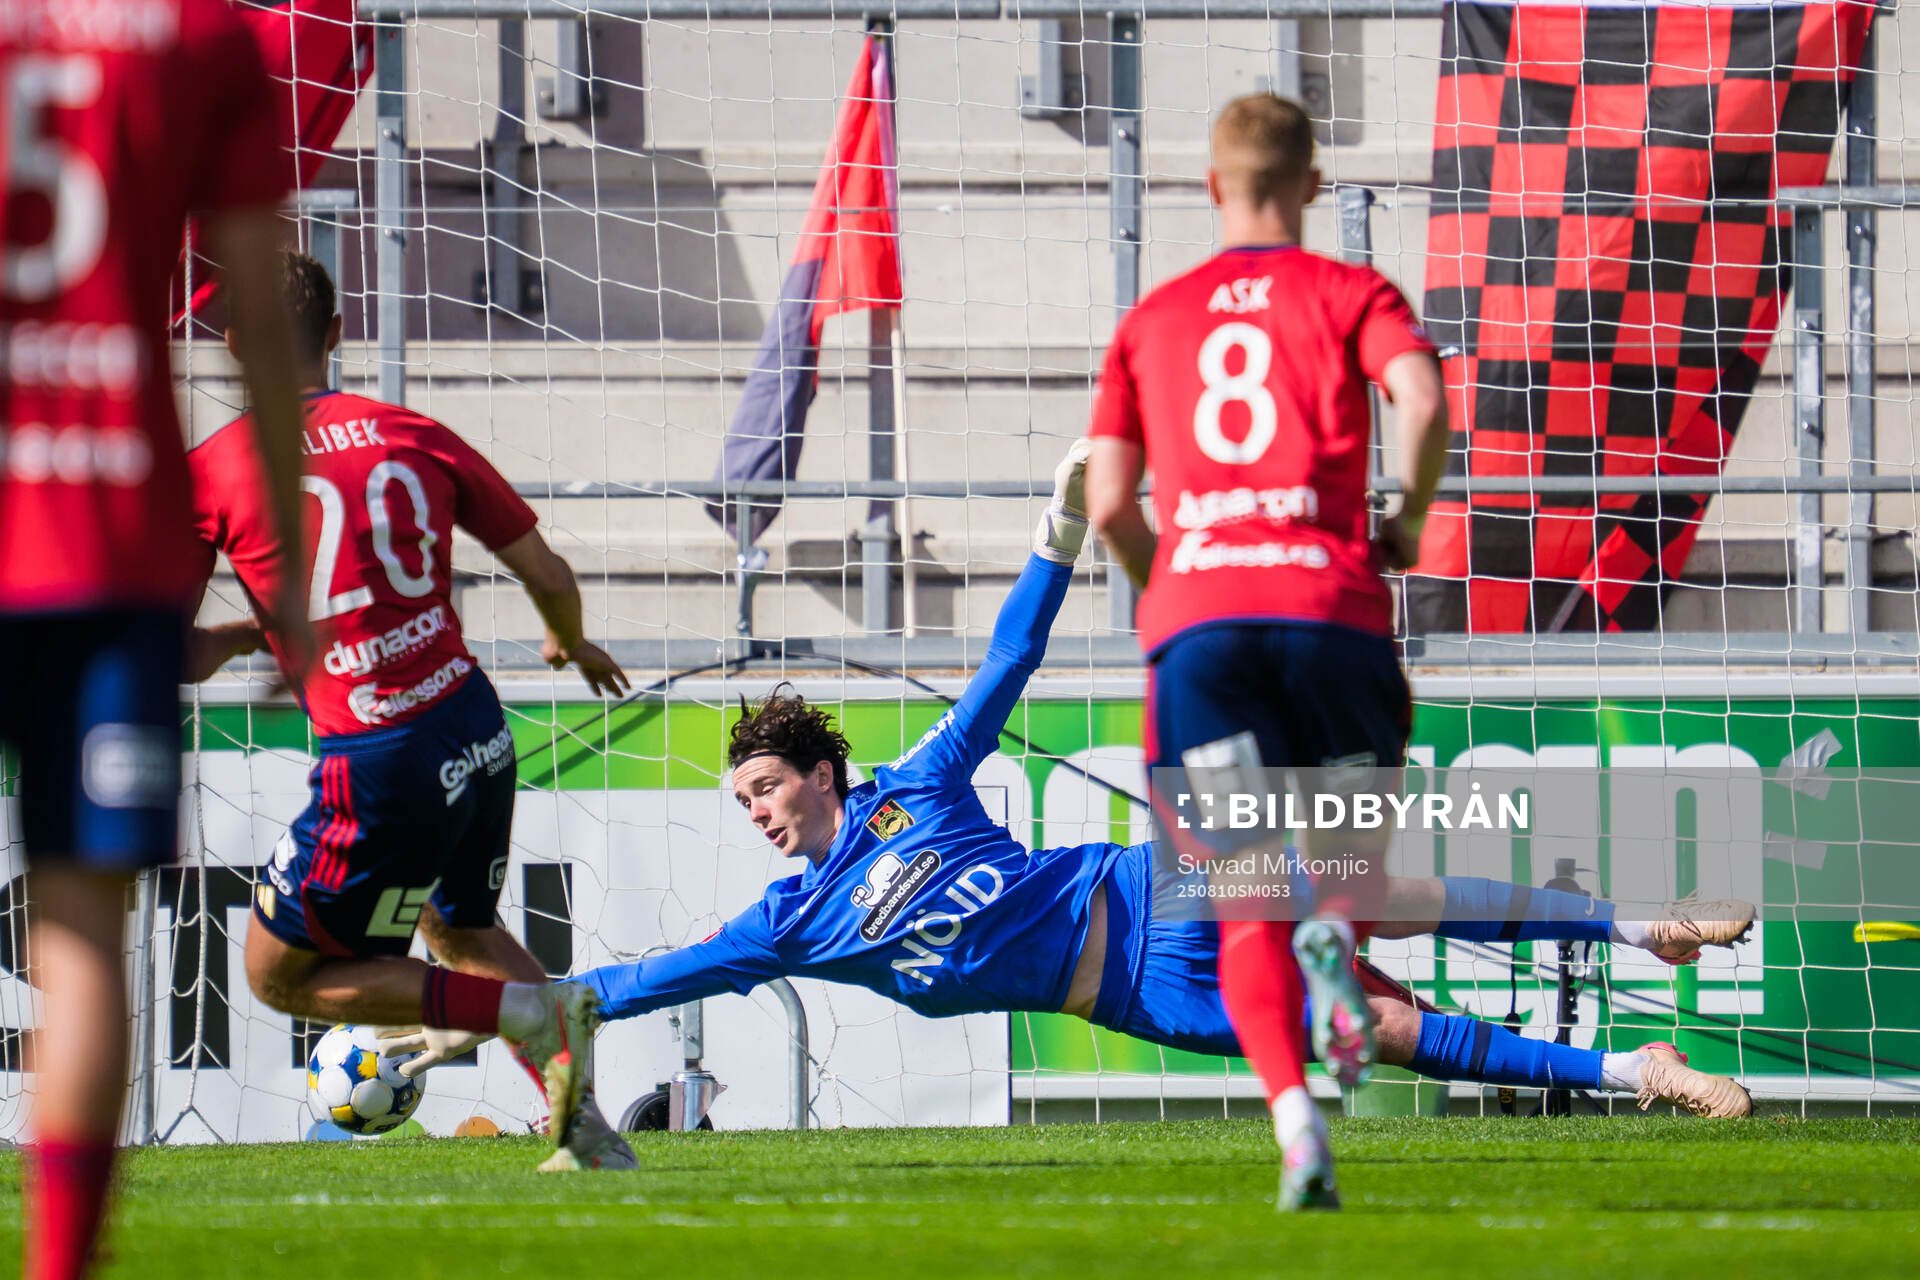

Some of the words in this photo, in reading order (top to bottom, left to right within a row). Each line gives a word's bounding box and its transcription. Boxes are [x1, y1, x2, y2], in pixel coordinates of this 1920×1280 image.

[1207, 275, 1273, 314] ASK
[1194, 321, 1277, 465] 8
[302, 417, 385, 455] LIBEK
[302, 460, 435, 622] 20
[324, 605, 446, 678] dynacon
[865, 854, 936, 937] bredbandsval.se
